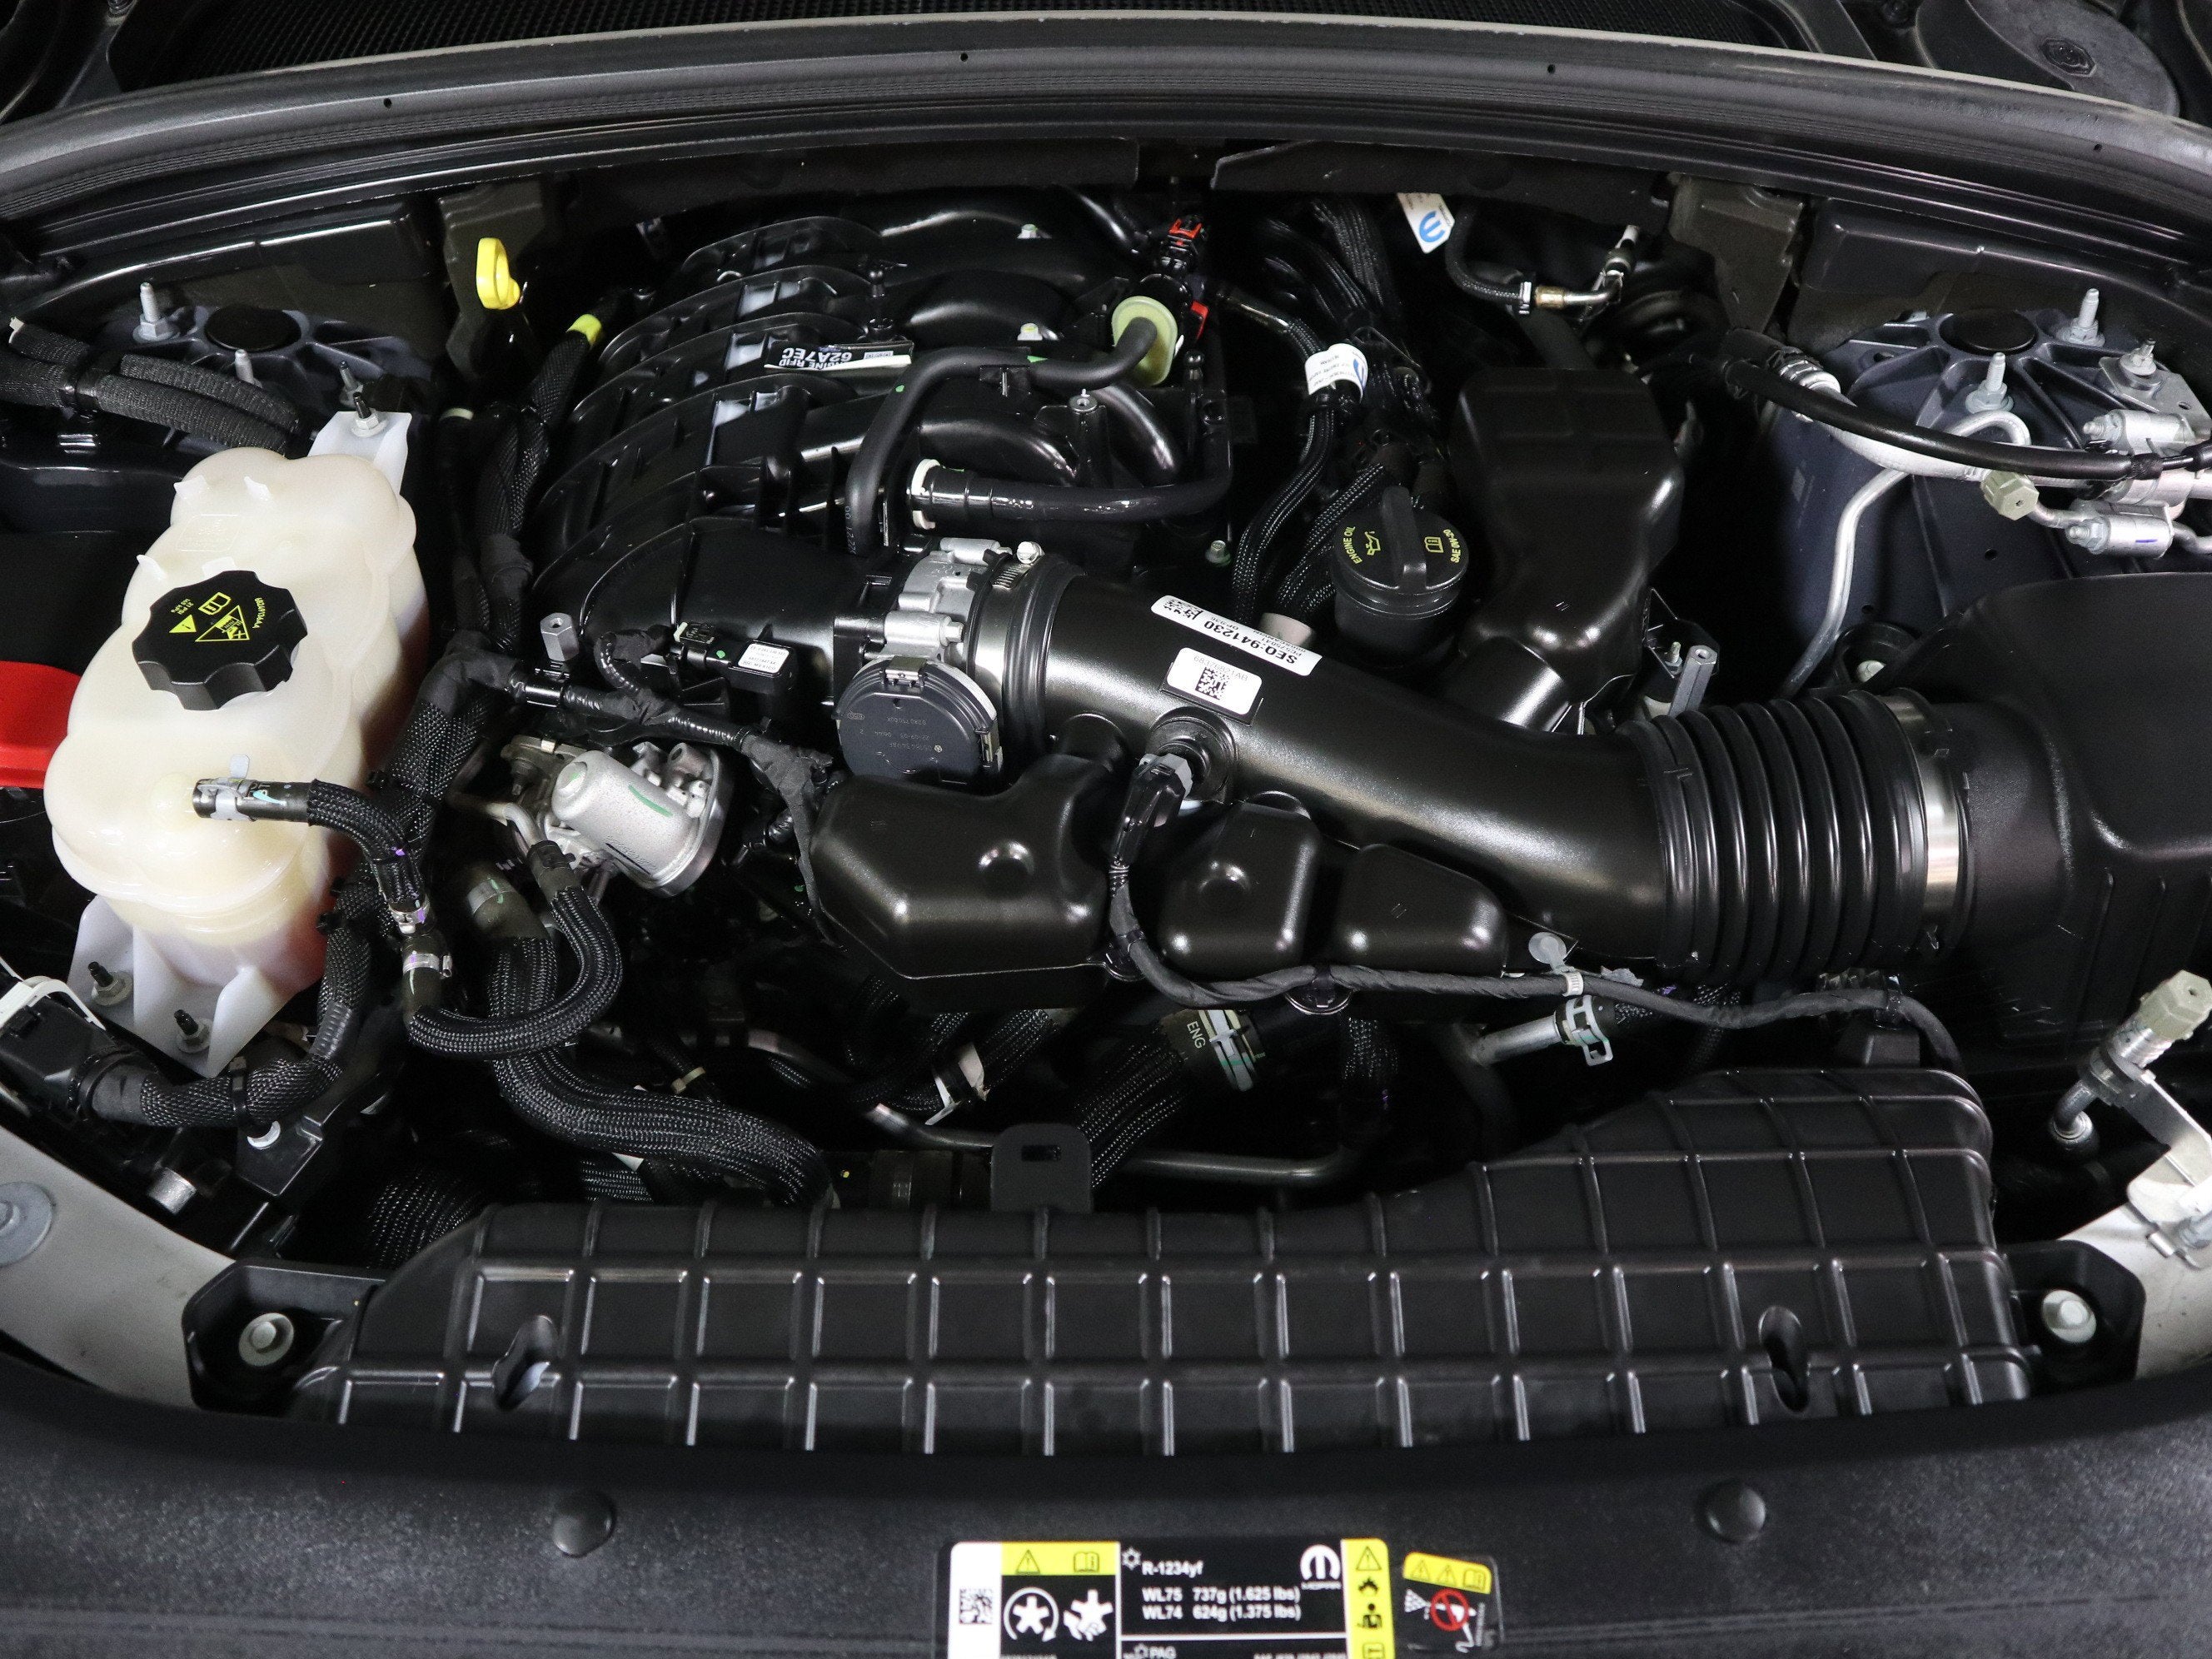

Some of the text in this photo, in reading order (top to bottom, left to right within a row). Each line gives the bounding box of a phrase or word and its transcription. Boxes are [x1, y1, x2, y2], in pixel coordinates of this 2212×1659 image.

[779, 358, 805, 368] RFID
[782, 346, 853, 363] 62A7EC
[1343, 526, 1363, 564] ENGINE OIL
[1442, 529, 1462, 563] SAE 0W-20
[1203, 620, 1298, 664] SEQ:941230
[1186, 1020, 1206, 1049] ENG
[1142, 1560, 1203, 1578] R-1234yf
[1143, 1587, 1183, 1602] WL75
[1193, 1587, 1227, 1605] 737g
[1228, 1586, 1272, 1605] (1.625
[1273, 1586, 1301, 1604] lbs)
[1143, 1604, 1301, 1622] WL74 624g (1.375 lbs)
